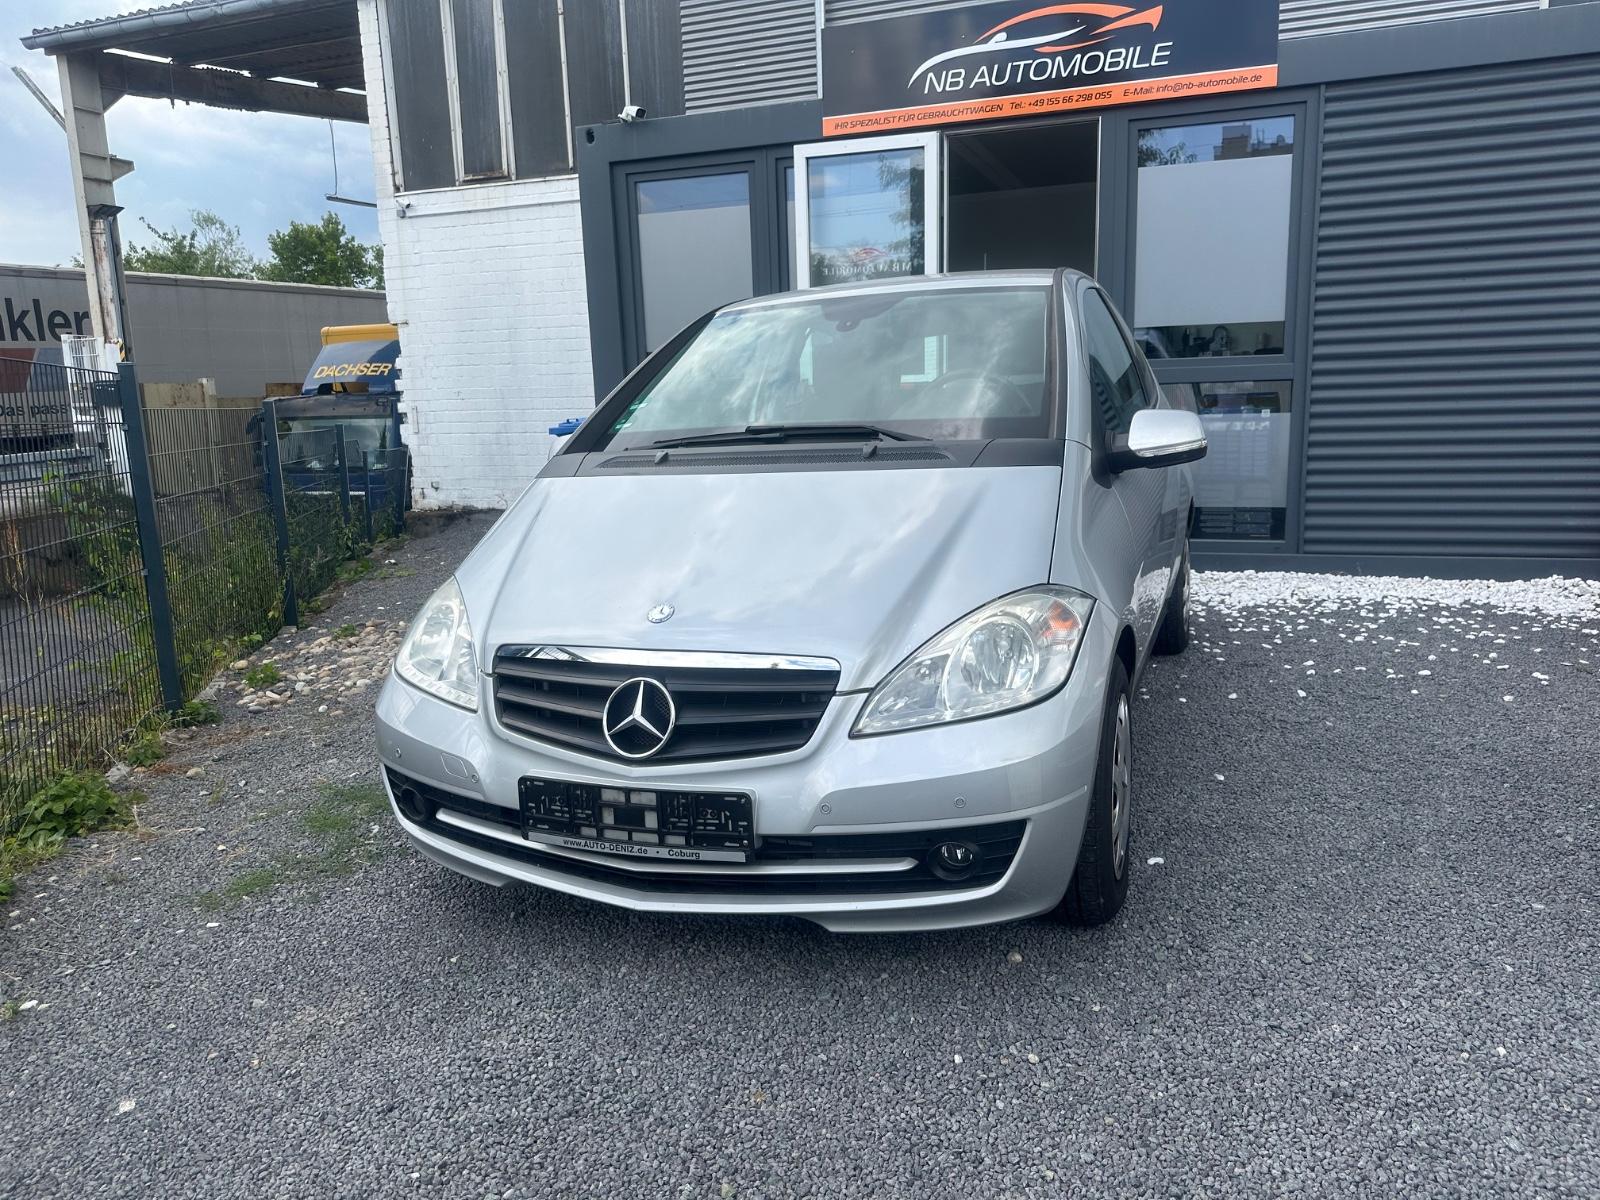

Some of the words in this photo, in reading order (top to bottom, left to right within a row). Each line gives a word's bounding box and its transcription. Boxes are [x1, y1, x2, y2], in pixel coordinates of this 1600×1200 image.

[923, 68, 966, 94] NB
[969, 41, 1174, 89] AUTOMOBILE
[834, 121, 849, 131] IHR
[850, 115, 897, 129] SPEZIALIST
[897, 113, 916, 123] FÜR
[917, 103, 1004, 121] GEBRAUCHTWAGEN
[1010, 101, 1026, 110] Tel.:
[1028, 98, 1045, 107] +49
[1046, 96, 1061, 106] 155
[1062, 95, 1074, 104] 66
[1075, 93, 1093, 102] 298
[1094, 91, 1112, 100] 055
[1123, 86, 1155, 97] E-Mail:
[1156, 73, 1262, 94] info@nb-automobile.de
[313, 363, 392, 379] DACHSER
[563, 839, 648, 855] www.AUTO-DENIZ.de
[668, 849, 700, 860] Coburg
